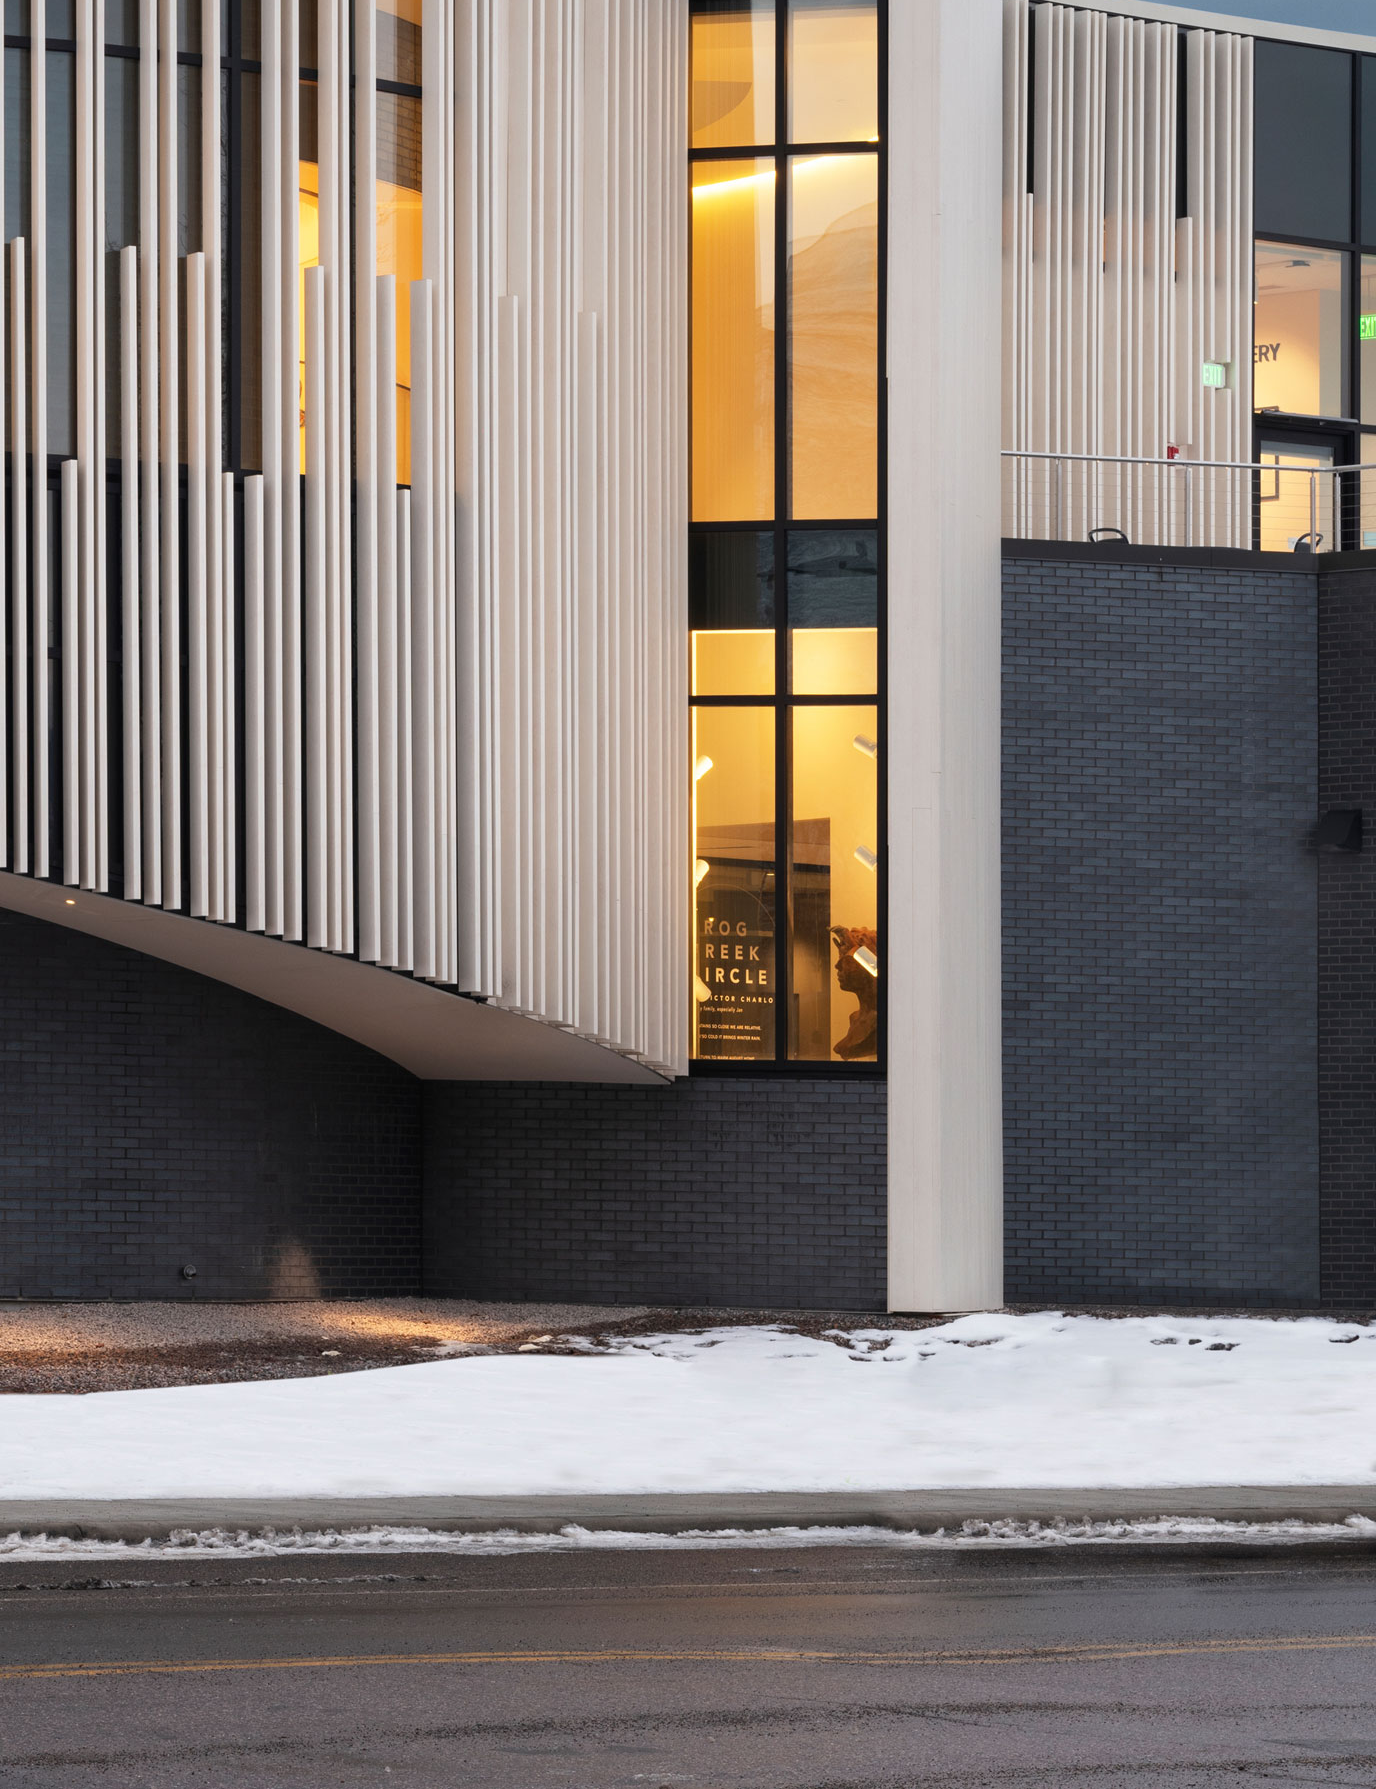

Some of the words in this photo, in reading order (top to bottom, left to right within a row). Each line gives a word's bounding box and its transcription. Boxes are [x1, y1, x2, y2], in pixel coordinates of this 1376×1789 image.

[1360, 316, 1376, 337] EXI
[1203, 365, 1223, 386] EXIT
[704, 920, 747, 937] ROG
[705, 943, 760, 961] REEK
[705, 967, 767, 985] IRCLE
[740, 996, 774, 1004] CHARLO
